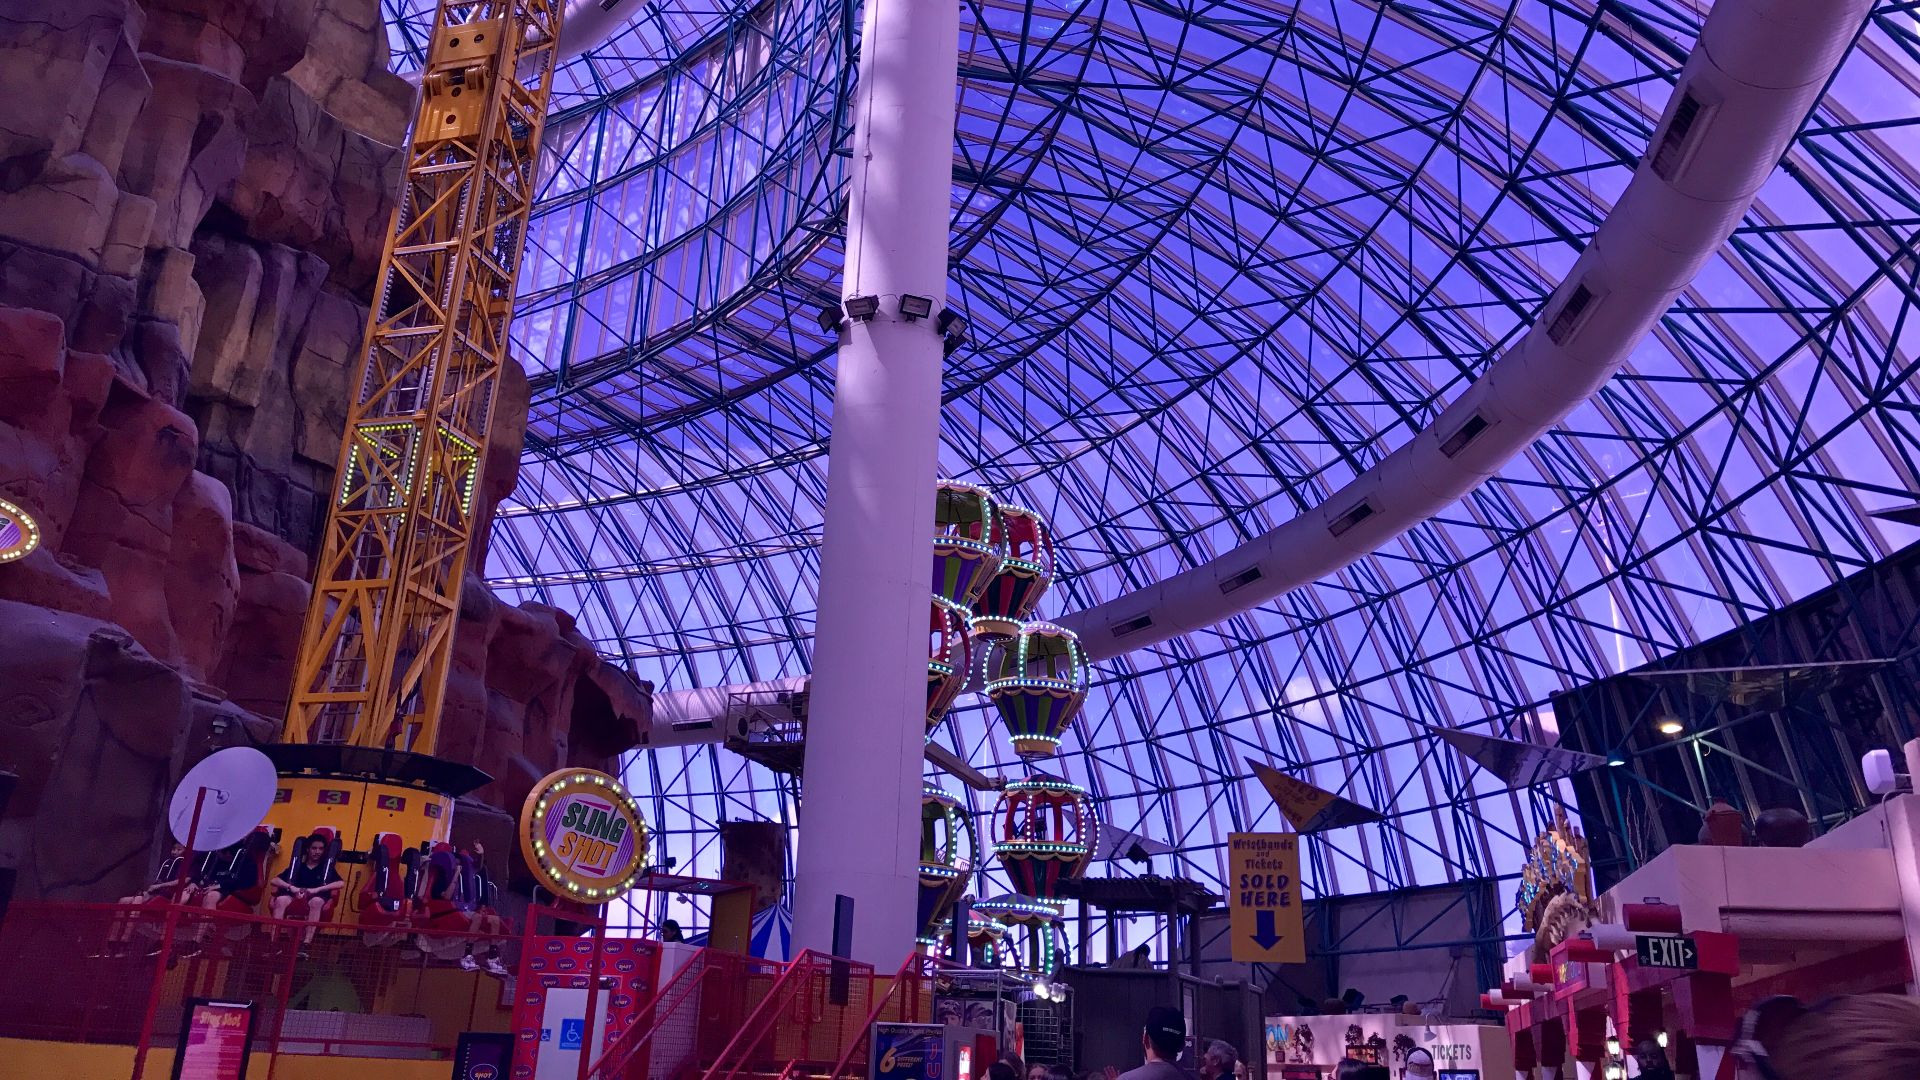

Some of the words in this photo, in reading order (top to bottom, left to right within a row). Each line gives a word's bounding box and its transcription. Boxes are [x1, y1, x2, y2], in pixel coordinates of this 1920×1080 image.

[326, 791, 342, 804] 3
[385, 797, 399, 810] 4
[429, 805, 440, 817] 5
[562, 803, 627, 843] SLING
[557, 832, 618, 872] SHOT
[1233, 839, 1293, 850] Wristbands
[1245, 859, 1283, 870] Tickets
[1240, 873, 1289, 889] SOLD
[1240, 891, 1291, 907] HERE
[1648, 938, 1685, 967] EXIT
[880, 1047, 897, 1073] 6
[1431, 1044, 1472, 1060] TICKETS
[474, 1072, 493, 1080] SHOT
